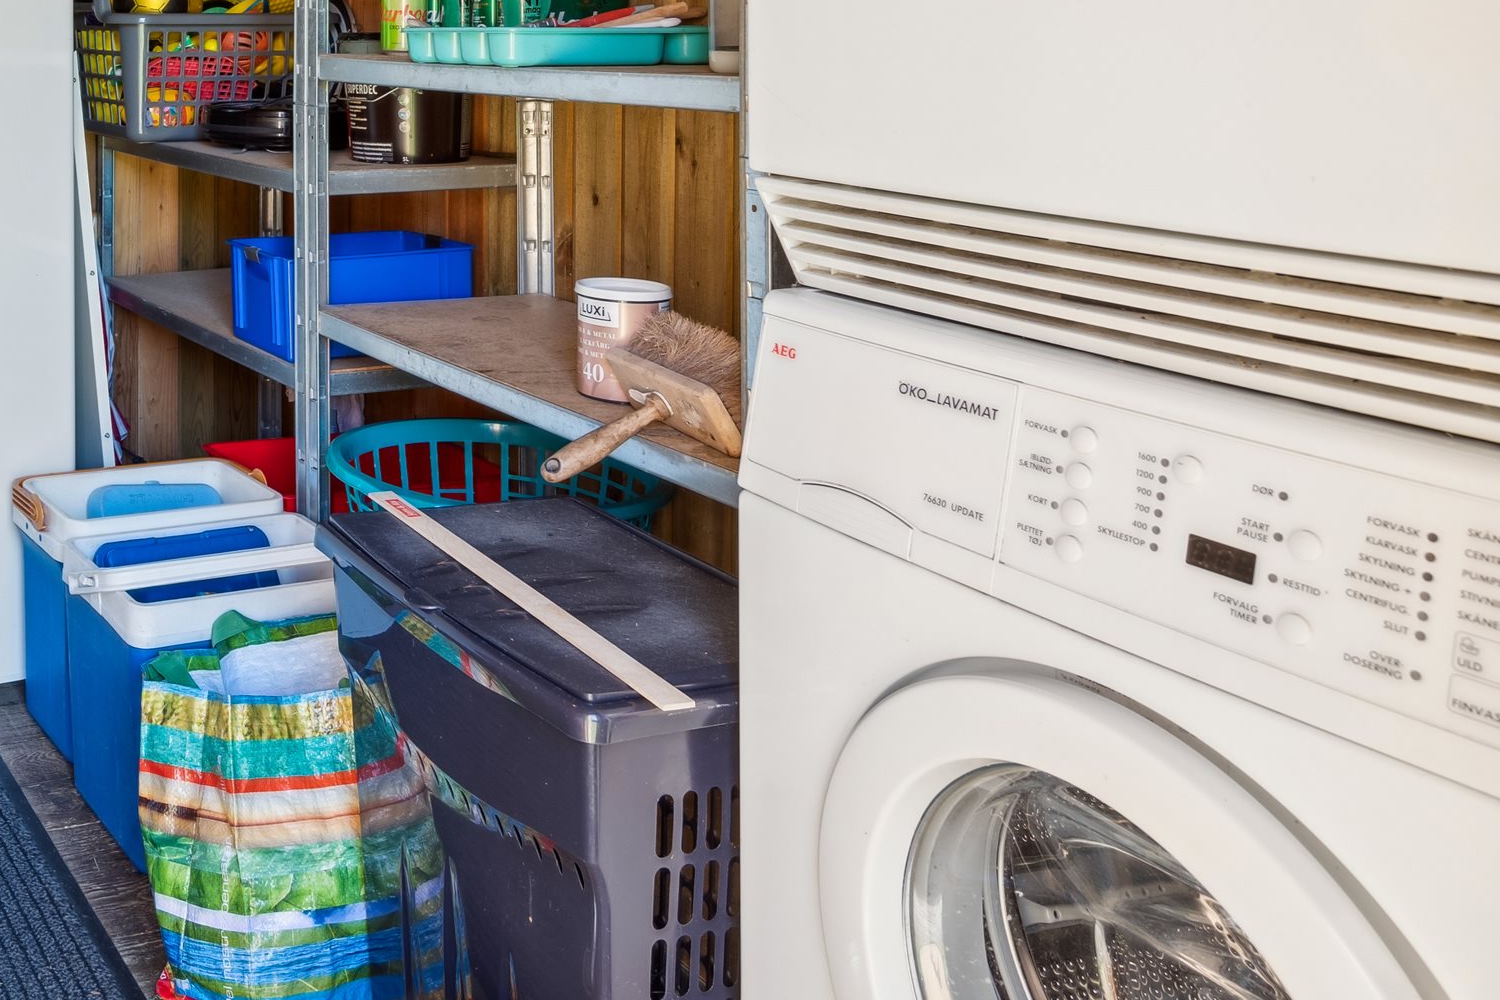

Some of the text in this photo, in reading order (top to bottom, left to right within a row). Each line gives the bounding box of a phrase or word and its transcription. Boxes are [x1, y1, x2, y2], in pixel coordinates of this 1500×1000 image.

[771, 342, 797, 359] AEG
[583, 362, 604, 383] 40
[1024, 419, 1058, 435] FORVASK
[1030, 453, 1053, 465] IBLØD-
[1138, 452, 1157, 463] 1600
[1018, 459, 1052, 475] SÆTNING
[1136, 469, 1155, 480] 1200
[1136, 486, 1152, 497] 900
[1252, 484, 1274, 497] DØR
[923, 492, 985, 522] 76630 UPDATE
[1027, 494, 1048, 505] KORT
[1134, 503, 1150, 514] 700
[1016, 522, 1043, 537] PLETTET
[1132, 520, 1148, 530] 400
[1241, 517, 1270, 532] START
[1367, 515, 1421, 538] FORVASK
[1028, 535, 1042, 547] TØJ
[1097, 525, 1146, 547] SKYLLESTOP
[1237, 527, 1269, 543] PAUSE
[1365, 535, 1418, 557] KLARVASK
[1358, 552, 1416, 577] SKYLNING
[1282, 577, 1322, 597] RESTTID
[1343, 568, 1401, 592] SKYLNING
[1213, 591, 1259, 614] FORVALG
[1345, 588, 1411, 616] CENTRIFUG.
[1229, 608, 1258, 624] TIMER
[1383, 620, 1409, 635] SLUT
[1343, 652, 1403, 681] DOSERING
[1369, 650, 1405, 668] OVER-
[1457, 656, 1483, 672] ULD
